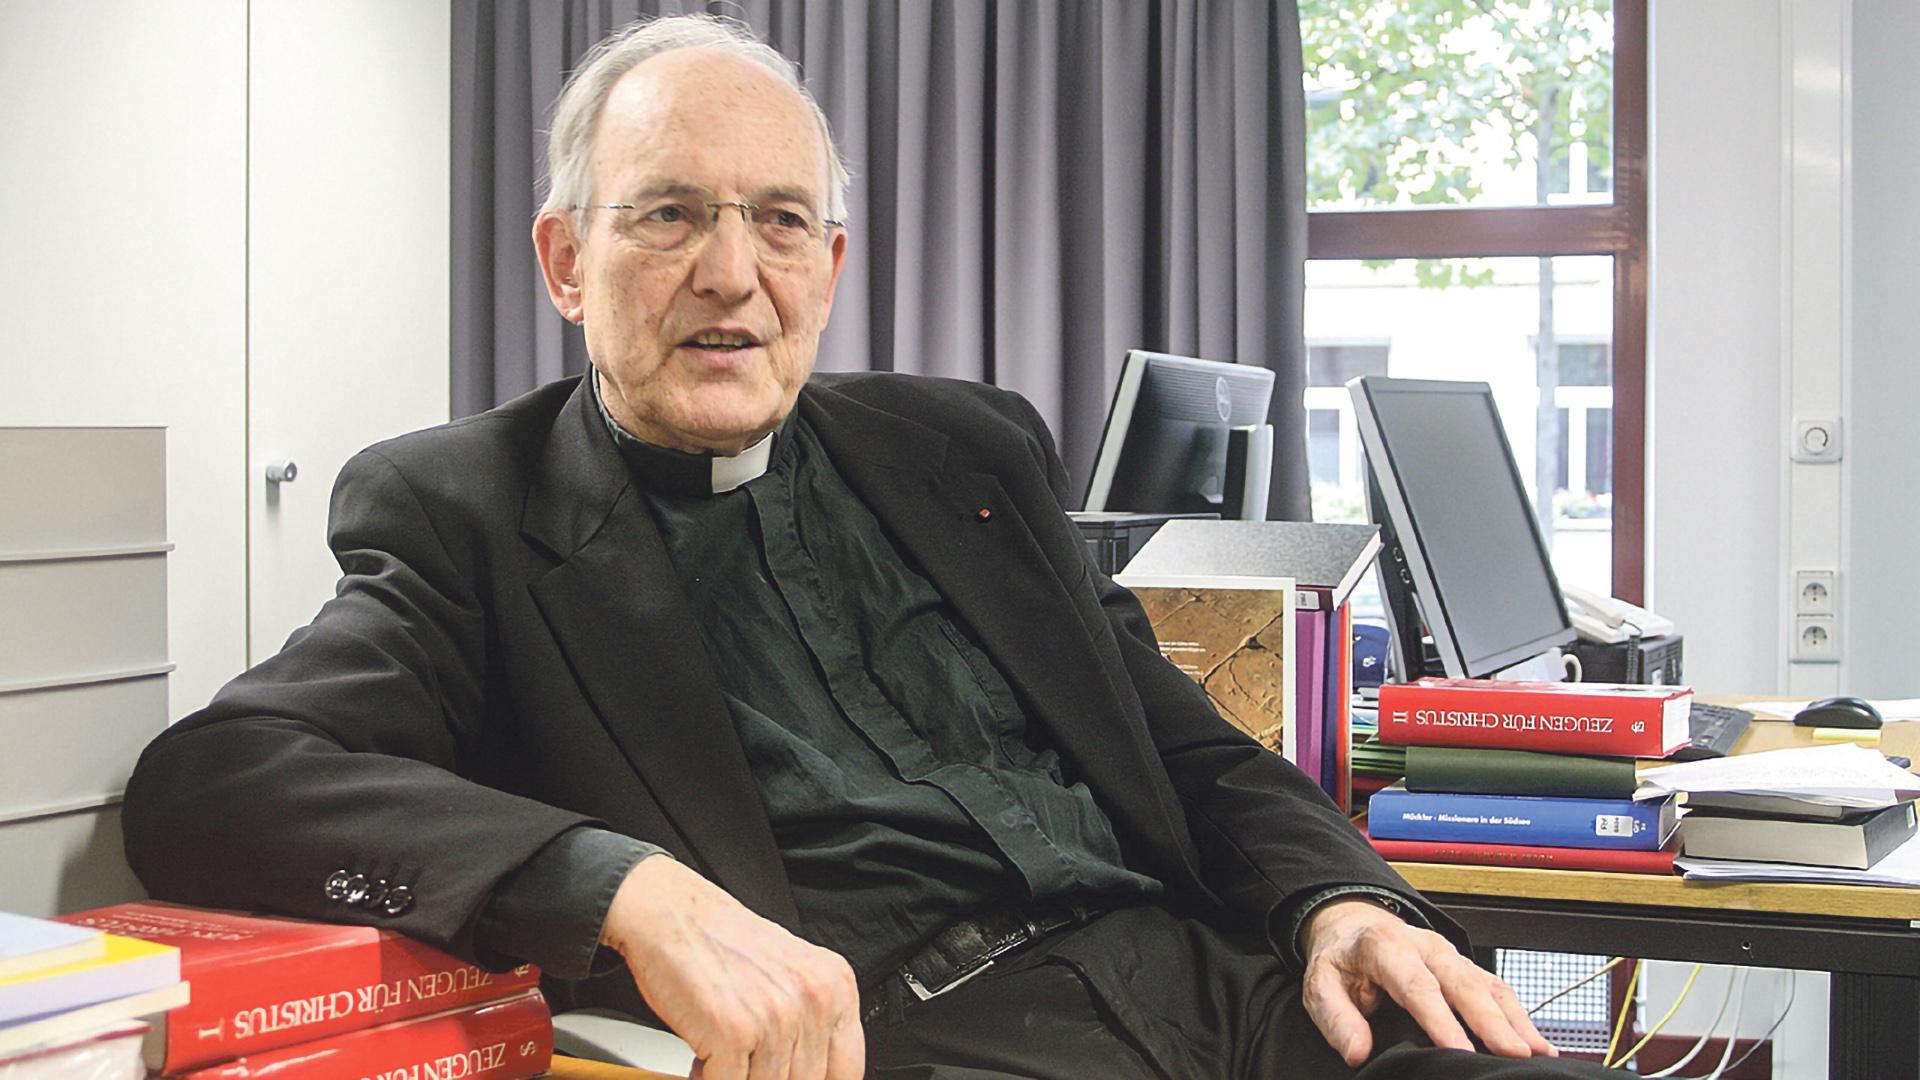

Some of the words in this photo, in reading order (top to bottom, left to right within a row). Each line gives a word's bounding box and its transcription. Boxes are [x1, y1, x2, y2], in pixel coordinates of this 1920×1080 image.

[1416, 709, 1499, 728] CHRISTUS
[1503, 712, 1538, 733] FÜR
[1540, 715, 1614, 734] ZEUGEN
[1489, 815, 1502, 824] der
[358, 979, 402, 1014] FÜR
[234, 990, 354, 1040] CHRISTUS
[424, 1042, 506, 1080] ZEUGEN
